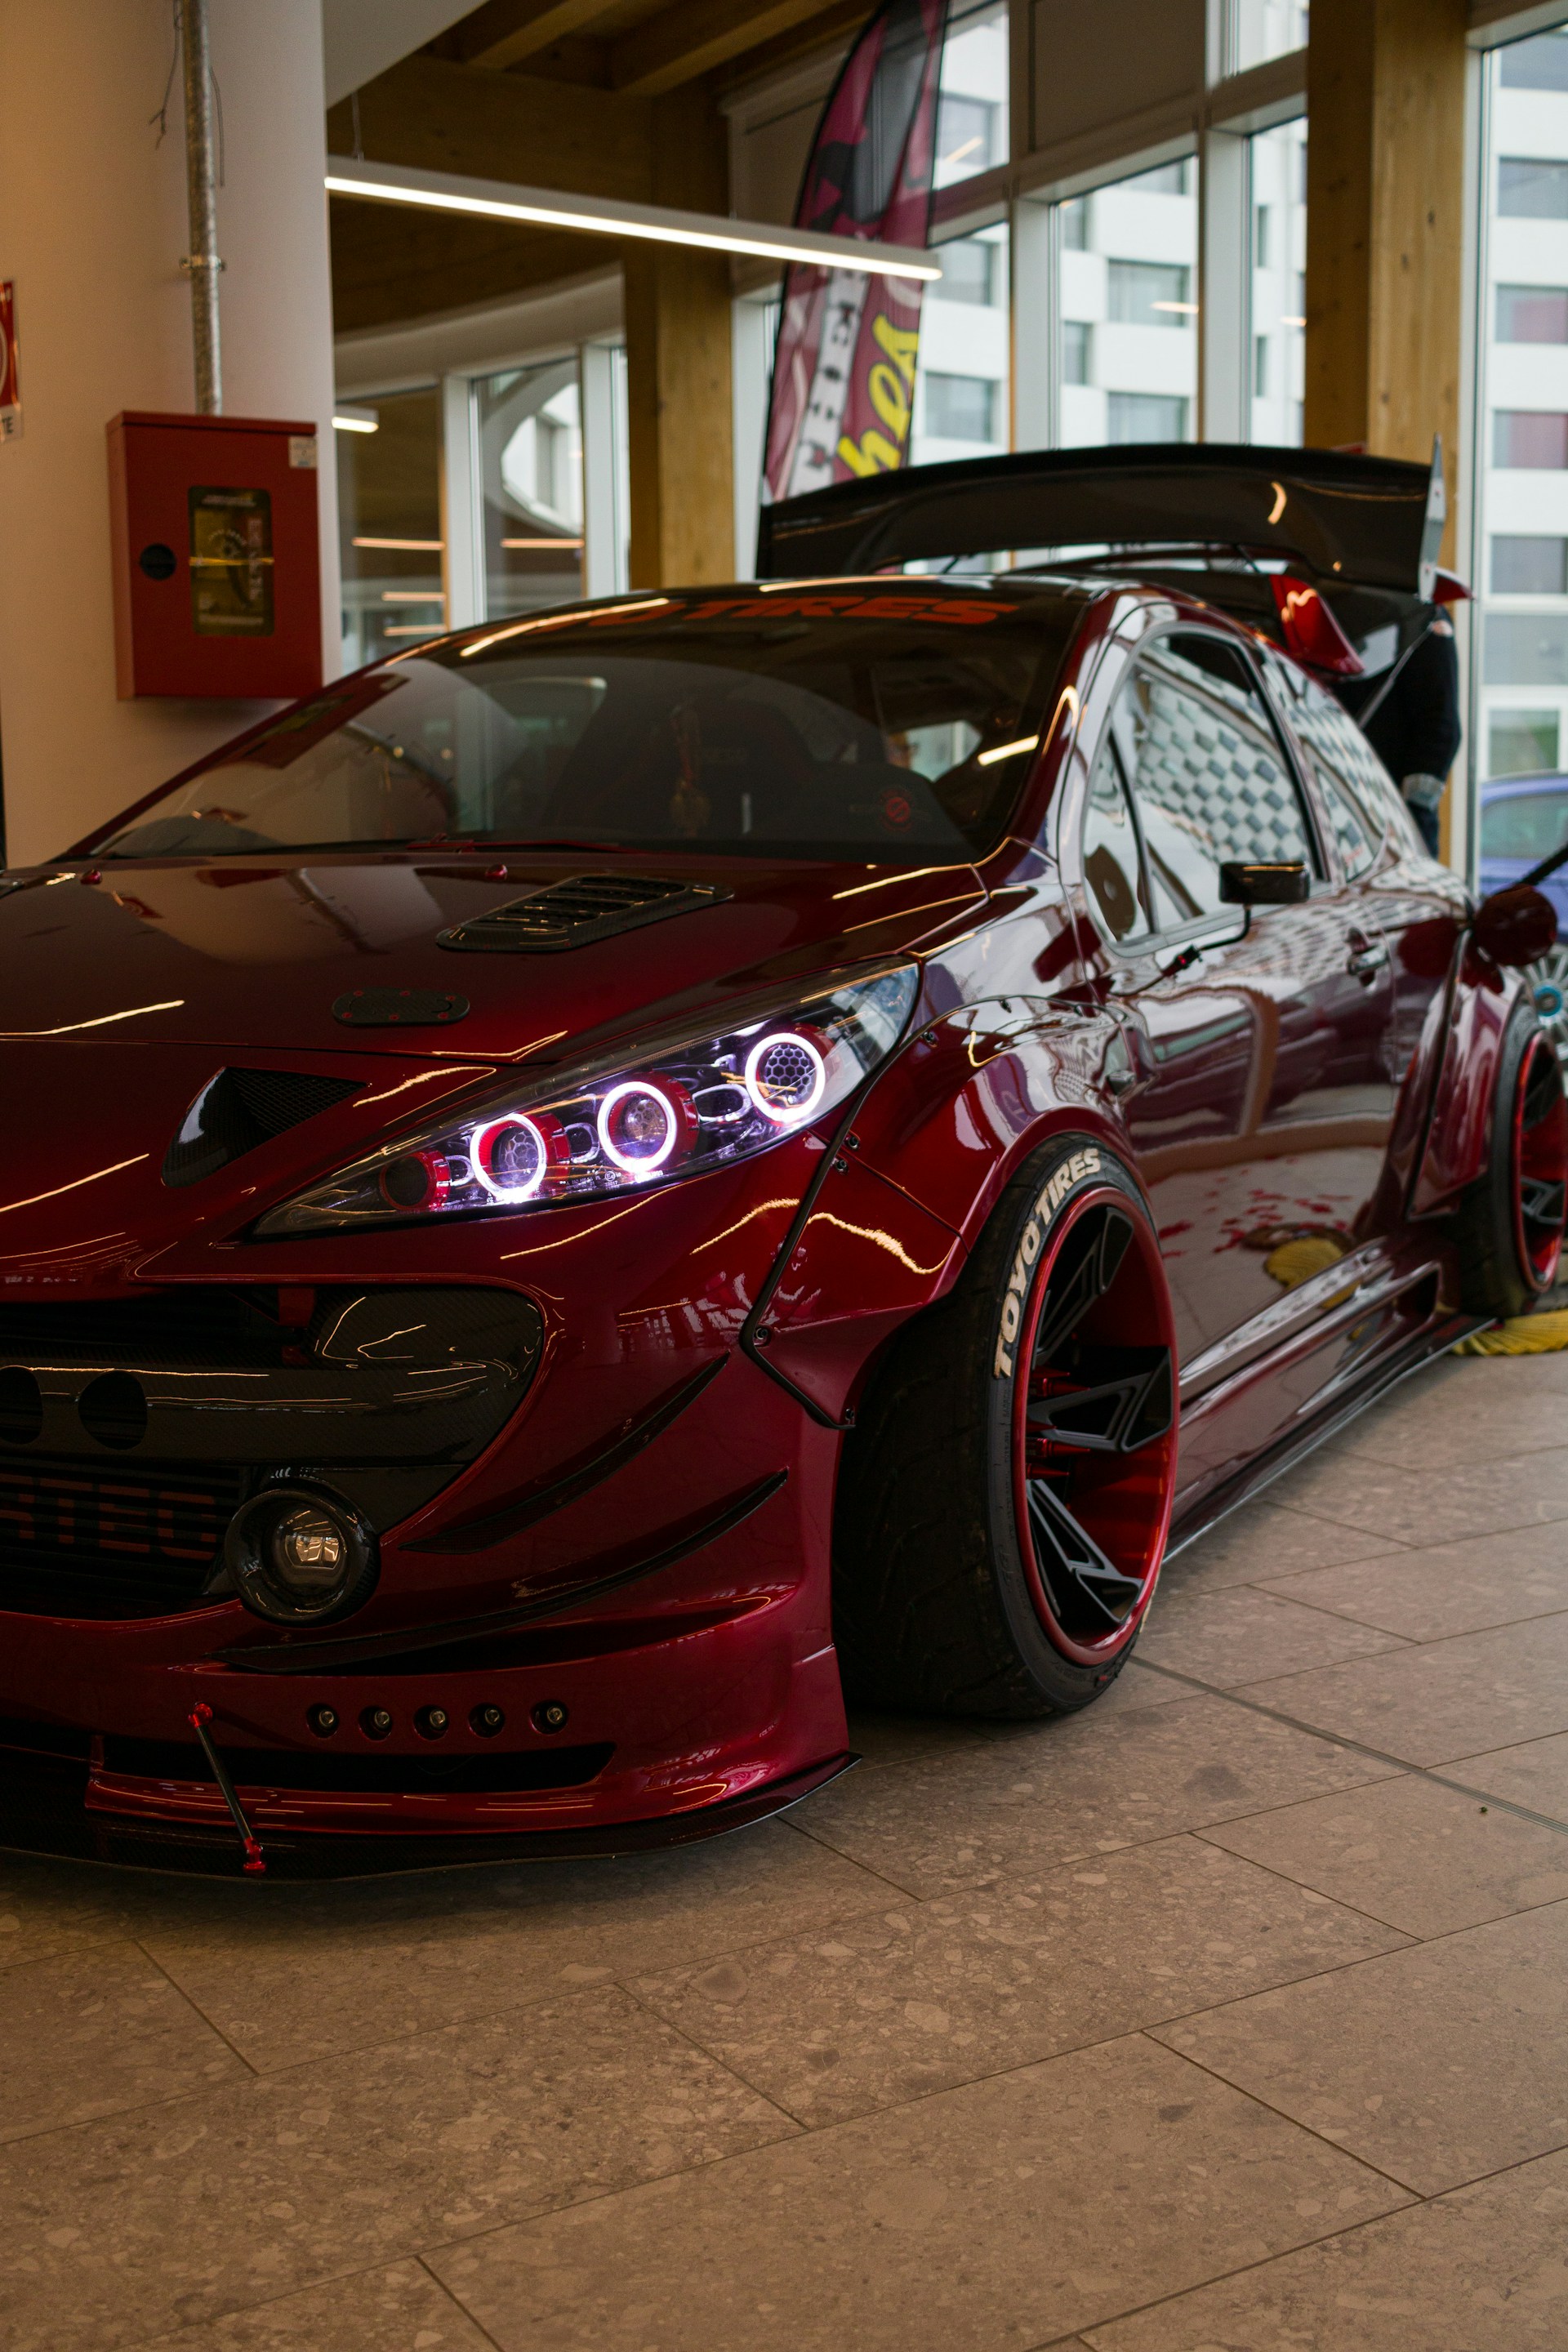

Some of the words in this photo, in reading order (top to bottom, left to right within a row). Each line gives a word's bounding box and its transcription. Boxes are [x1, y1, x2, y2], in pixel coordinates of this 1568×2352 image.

[682, 596, 1020, 625] TIRES
[993, 1219, 1042, 1379] TOYO
[1034, 1147, 1102, 1225] TIRES
